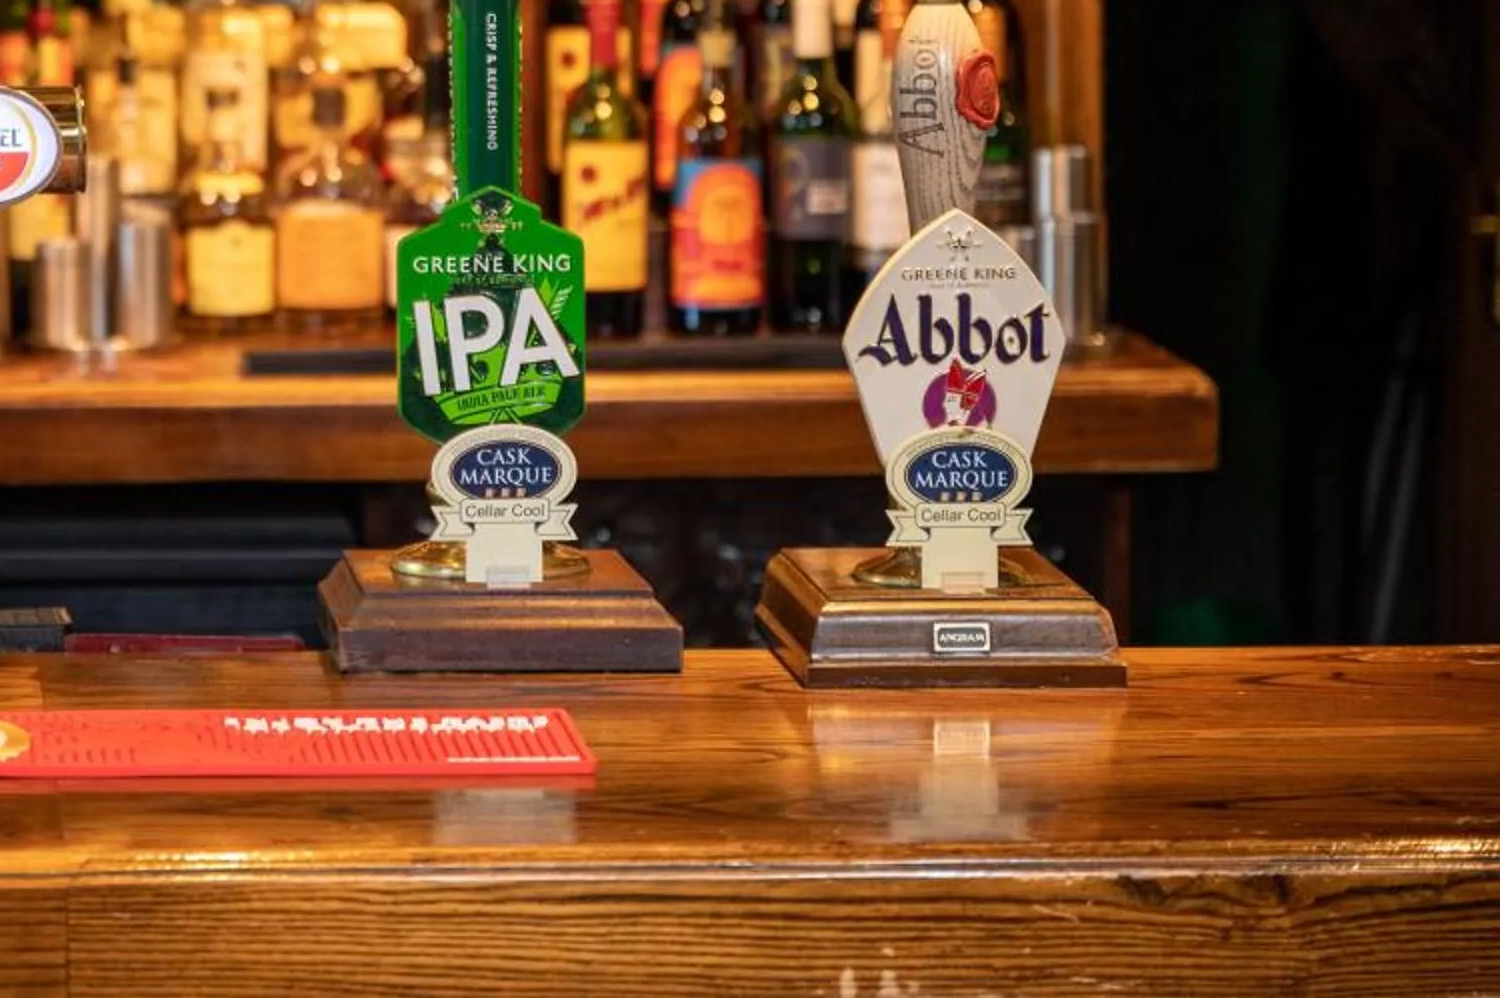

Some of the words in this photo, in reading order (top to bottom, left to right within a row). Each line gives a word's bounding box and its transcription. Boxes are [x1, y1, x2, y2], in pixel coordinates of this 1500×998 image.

[485, 11, 498, 52] CRISP
[899, 35, 946, 158] Abbot
[485, 67, 499, 151] REFRESHING
[412, 253, 504, 274] GREENE
[513, 253, 572, 273] KING
[901, 268, 969, 282] GREENE
[973, 267, 1018, 281] KING
[855, 292, 1051, 367] Abbot
[412, 287, 581, 397] IPA
[476, 448, 533, 466] CASK
[931, 451, 988, 469] CASK
[459, 467, 553, 487] MARQUE
[914, 470, 1010, 490] MARQUE
[465, 503, 508, 518] Cellar
[511, 503, 546, 518] Cool
[921, 508, 964, 522] Cellar
[967, 507, 1001, 522] Cool
